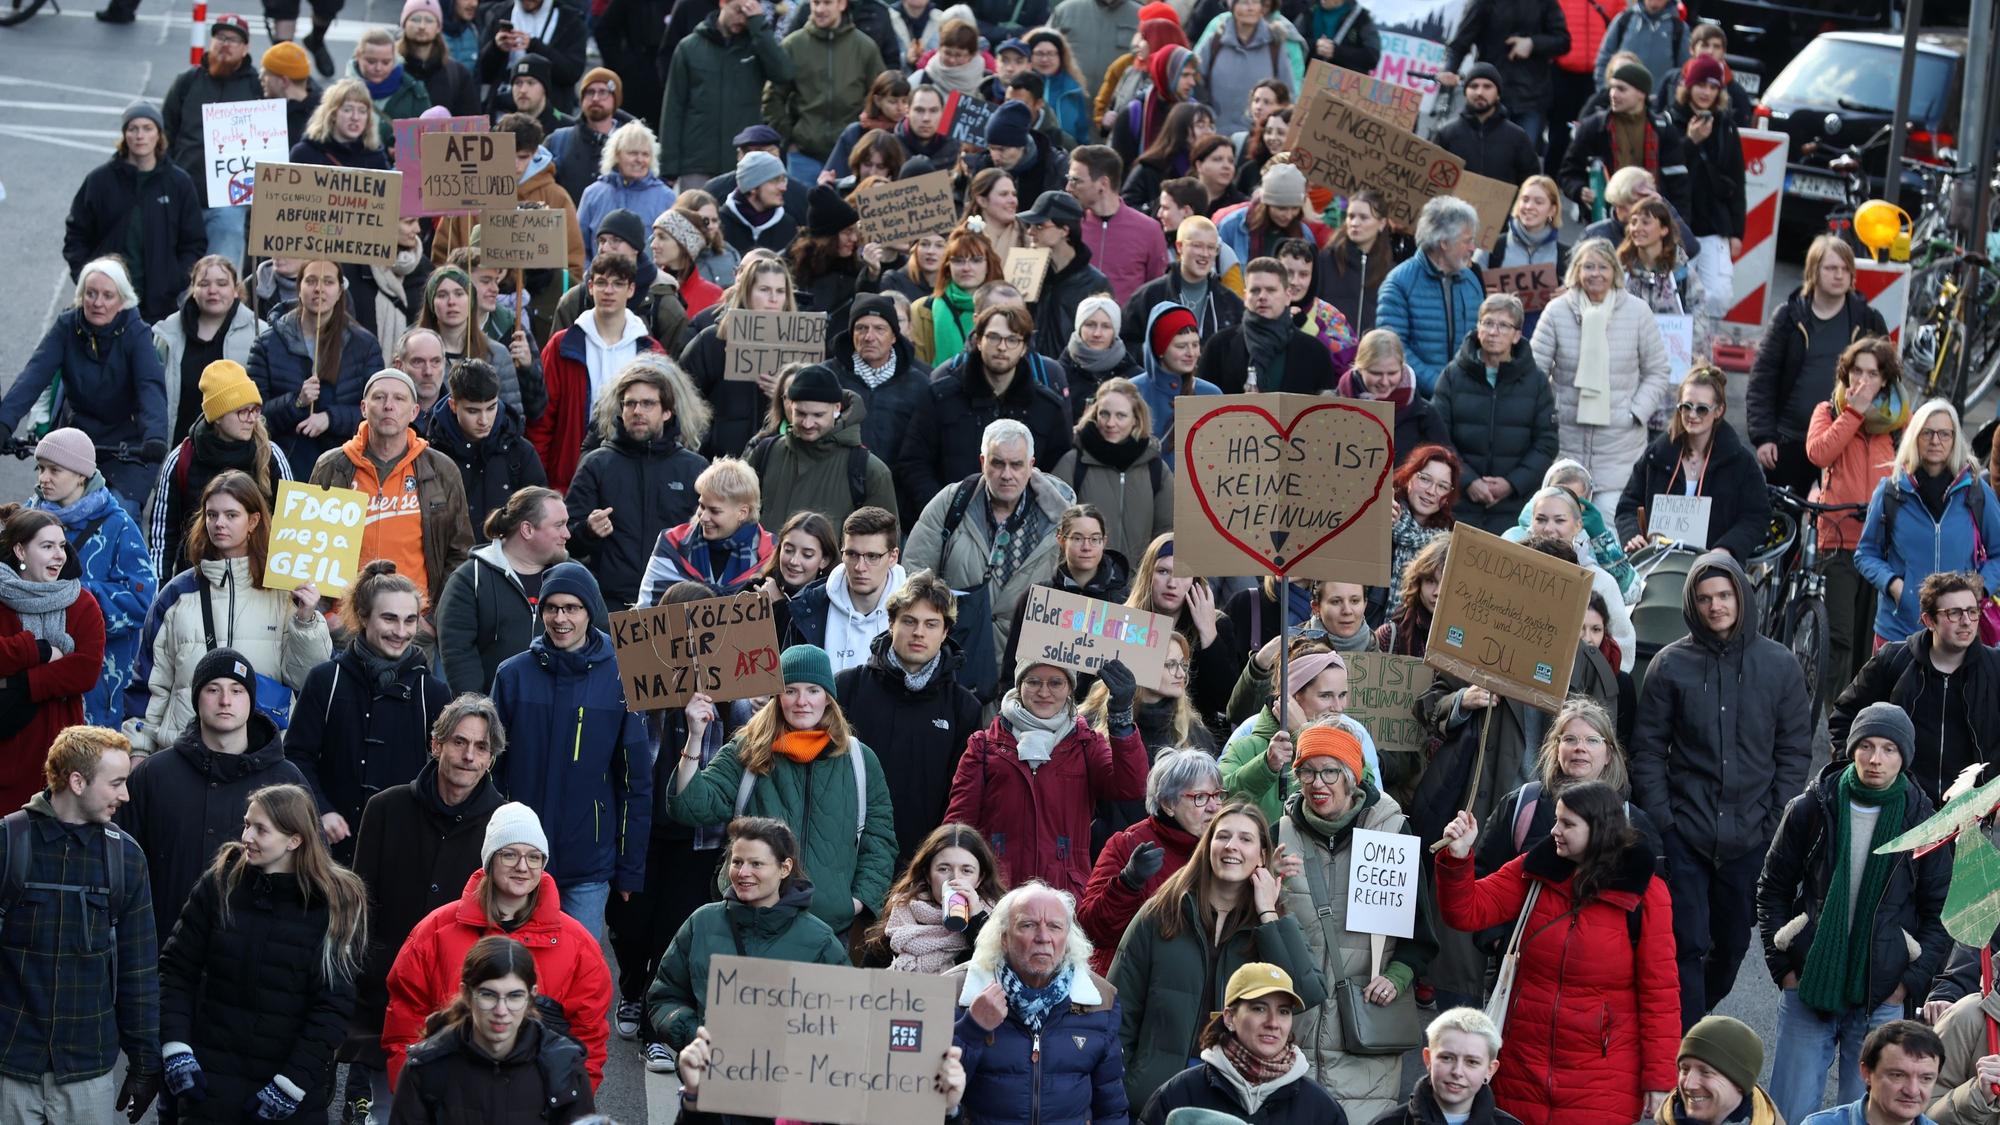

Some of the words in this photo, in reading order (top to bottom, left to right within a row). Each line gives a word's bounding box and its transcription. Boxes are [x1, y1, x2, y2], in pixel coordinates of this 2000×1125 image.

[952, 122, 987, 149] Naz
[1322, 98, 1386, 150] FINGER
[445, 135, 494, 162] AFD
[262, 167, 302, 185] AFD
[314, 169, 387, 198] WÄHLEN
[424, 174, 461, 197] 1933
[328, 194, 368, 209] DUMM
[304, 222, 344, 236] GEGEN
[489, 214, 519, 229] KEINE
[522, 214, 562, 228] MACHT
[511, 231, 536, 243] DEN
[486, 247, 535, 262] RECHTEN
[733, 315, 767, 342] NIE
[734, 347, 769, 374] IST
[1227, 434, 1306, 464] HASS
[1334, 441, 1385, 469] IST
[1216, 473, 1303, 498] KEINE
[283, 489, 363, 528] FDGO
[1226, 503, 1343, 530] MEINUNG
[276, 527, 350, 554] mega
[269, 551, 349, 588] GEIL
[686, 592, 771, 631] KÖLSCH
[1025, 587, 1062, 626] Lieber
[1061, 598, 1159, 648] solidarisch
[1462, 601, 1490, 625] 1933
[1493, 620, 1512, 633] und
[1042, 641, 1081, 665] solide
[1075, 633, 1095, 648] als
[734, 646, 779, 678] AFD
[1379, 656, 1424, 690] IST
[633, 666, 722, 701] NAZIS
[1352, 686, 1415, 710] MEINUN
[1363, 841, 1406, 865] OMAS
[1356, 864, 1408, 888] GEGEN
[1354, 887, 1405, 908] RECHTS
[892, 1025, 917, 1037] FCK
[892, 1036, 916, 1047] AFD
